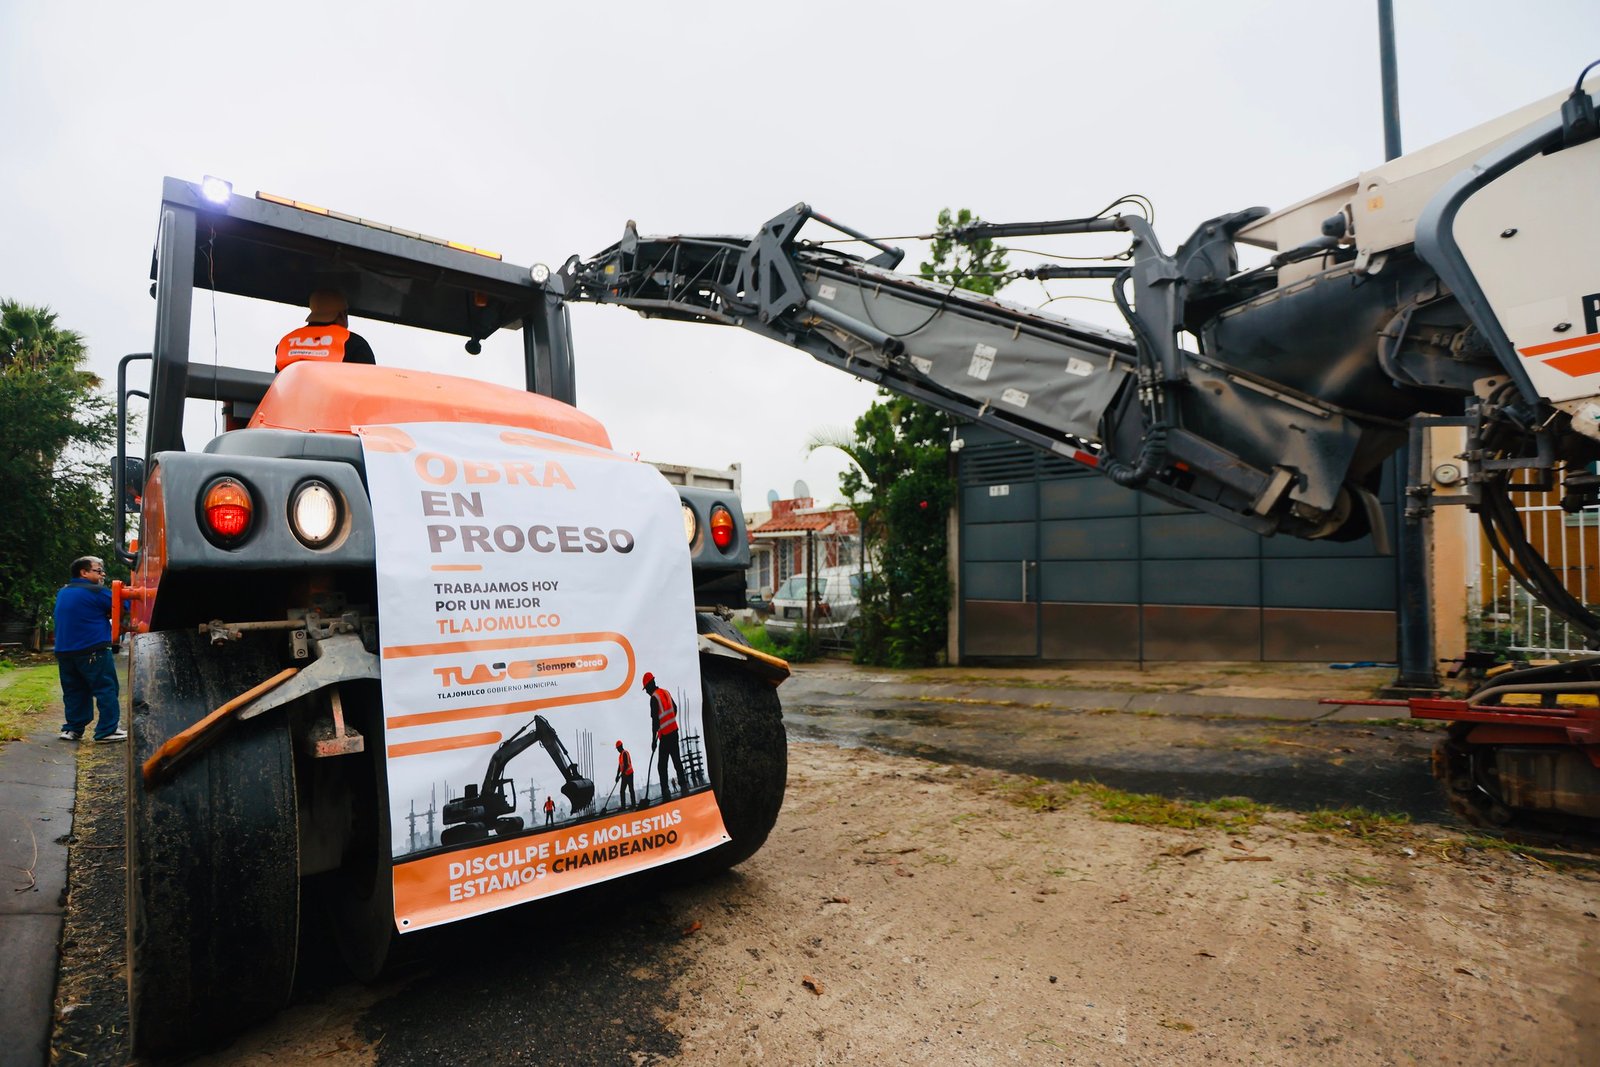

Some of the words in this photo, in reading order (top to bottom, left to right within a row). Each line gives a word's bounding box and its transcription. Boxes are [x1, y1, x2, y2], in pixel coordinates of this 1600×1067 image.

[414, 452, 577, 490] OBRA
[420, 490, 485, 518] EN
[426, 524, 635, 554] PROCESO
[434, 582, 529, 595] TRABAJAMOS
[532, 580, 560, 592] HOY
[435, 600, 467, 612] POR
[470, 599, 491, 611] UN
[495, 597, 541, 610] MEJOR
[436, 613, 562, 635] TLAJOMULCO
[437, 688, 485, 700] TLAJOMULCO
[486, 684, 523, 694] GOBIERNO
[523, 680, 559, 690] MUNICIPAL
[448, 842, 550, 881] DISCULPE
[554, 833, 589, 856] LAS
[592, 809, 683, 846] MOLESTIAS
[449, 862, 547, 902] ESTAMOS
[551, 830, 678, 874] CHAMBEANDO
